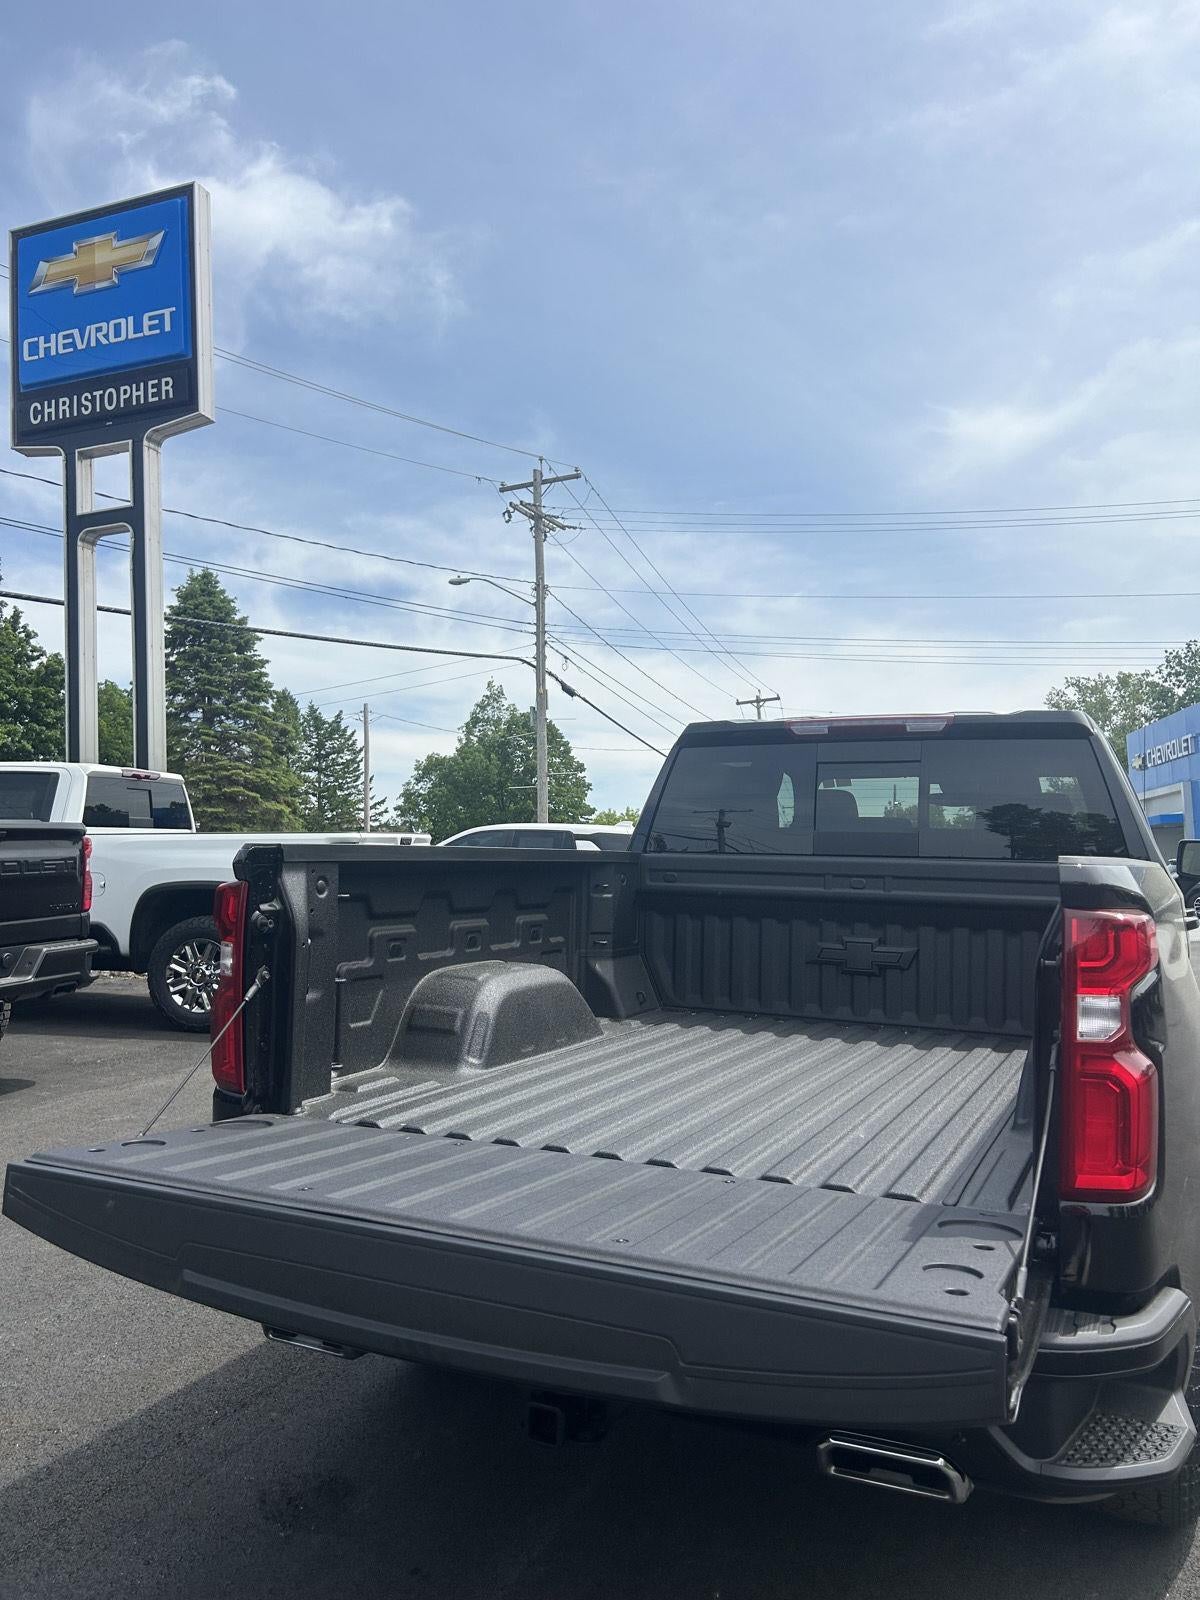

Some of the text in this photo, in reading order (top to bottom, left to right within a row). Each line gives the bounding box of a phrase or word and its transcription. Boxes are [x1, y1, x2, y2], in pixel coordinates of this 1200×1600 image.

[23, 306, 176, 362] CHEVROLET
[29, 376, 174, 425] CHRISTOPHER
[1146, 734, 1193, 767] CHEVROLET
